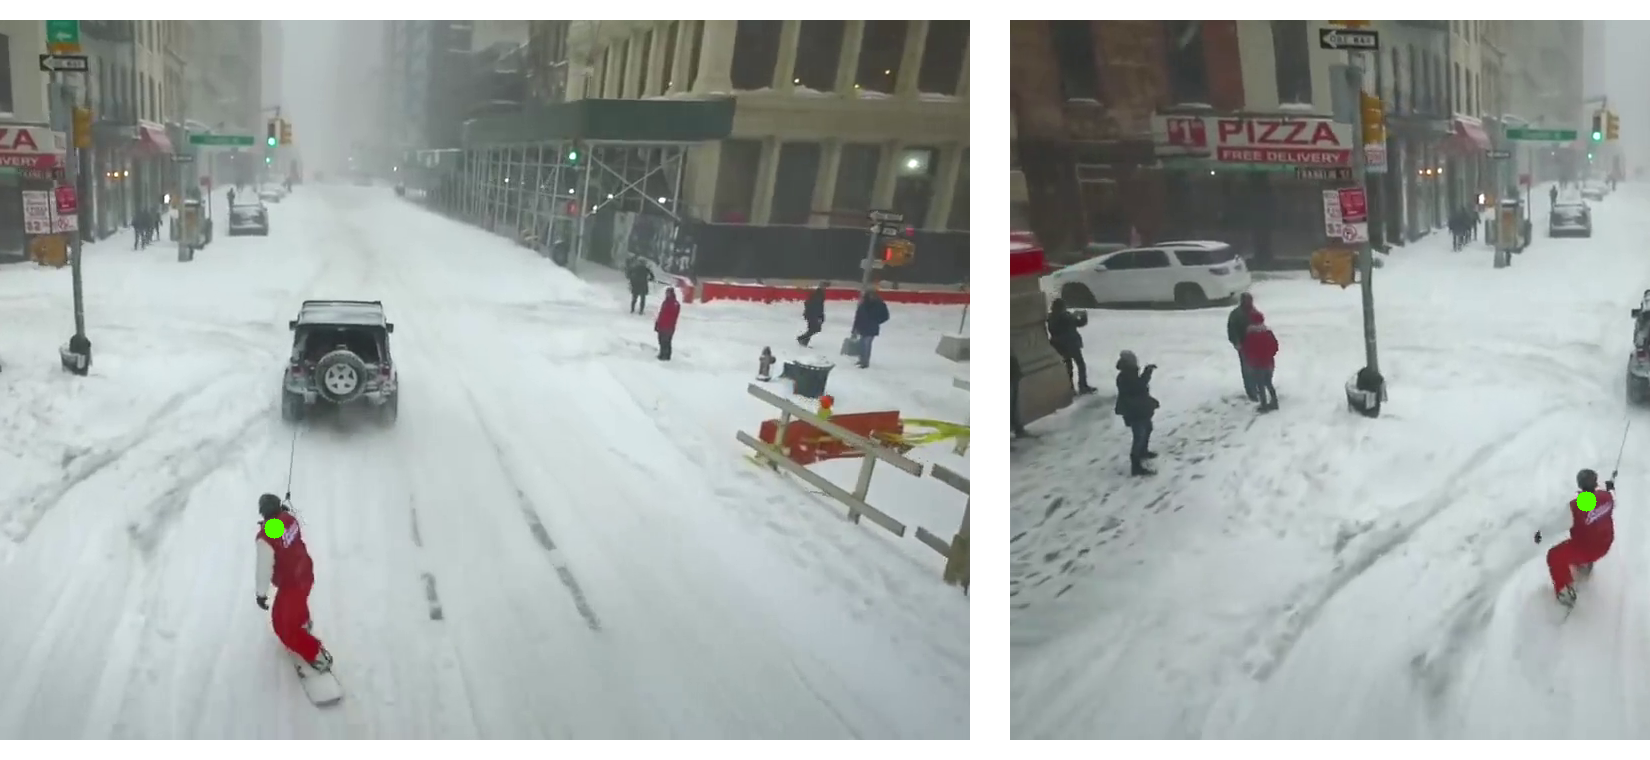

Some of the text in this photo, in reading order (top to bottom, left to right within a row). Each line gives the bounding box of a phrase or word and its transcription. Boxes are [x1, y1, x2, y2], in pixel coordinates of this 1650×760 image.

[1217, 119, 1340, 146] PIZZA
[1223, 150, 1340, 163] FREE DELIVERY
